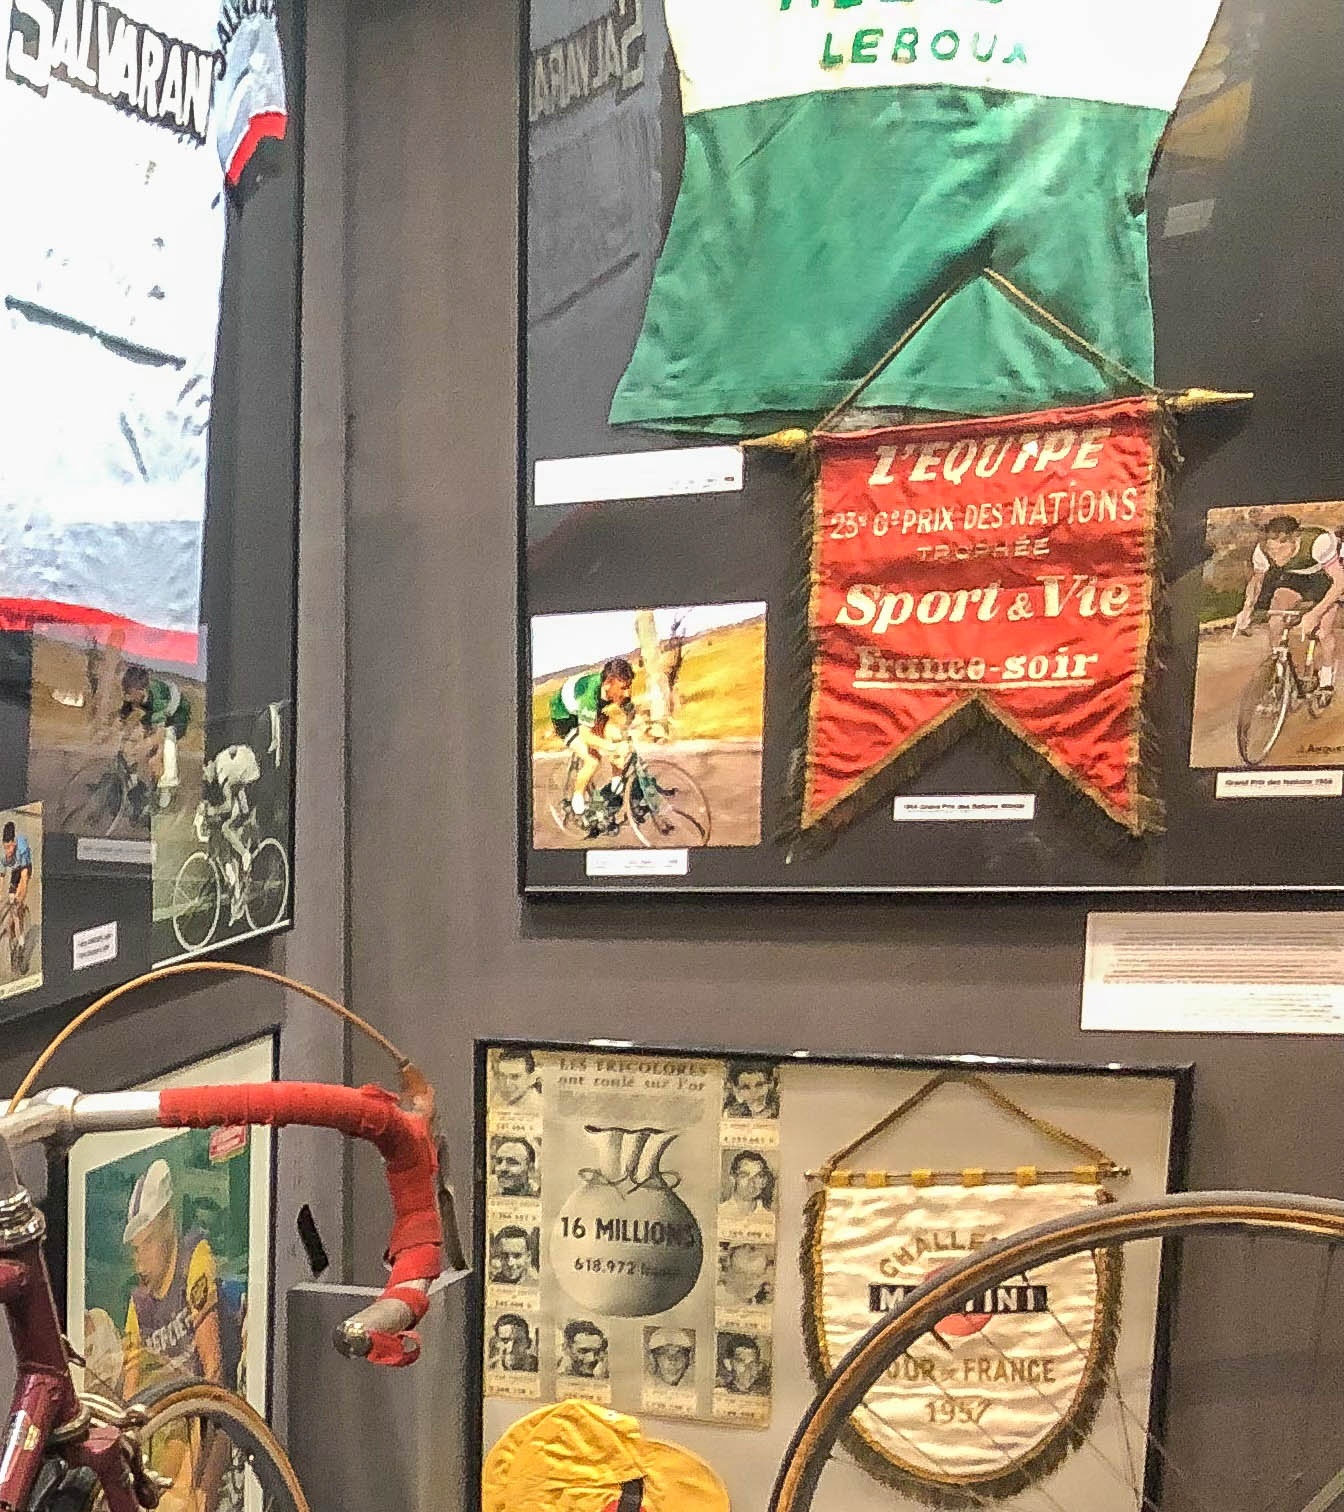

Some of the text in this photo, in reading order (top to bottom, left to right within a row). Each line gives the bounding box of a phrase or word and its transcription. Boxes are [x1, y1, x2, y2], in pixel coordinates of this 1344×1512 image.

[901, 507, 955, 535] PRIX
[964, 503, 1003, 530] DES
[835, 574, 1131, 634] Sport & Vie
[561, 1216, 586, 1239] 16
[886, 1358, 936, 1382] OUR
[963, 1357, 1057, 1383] FRANCE
[925, 1399, 993, 1425] 1957
